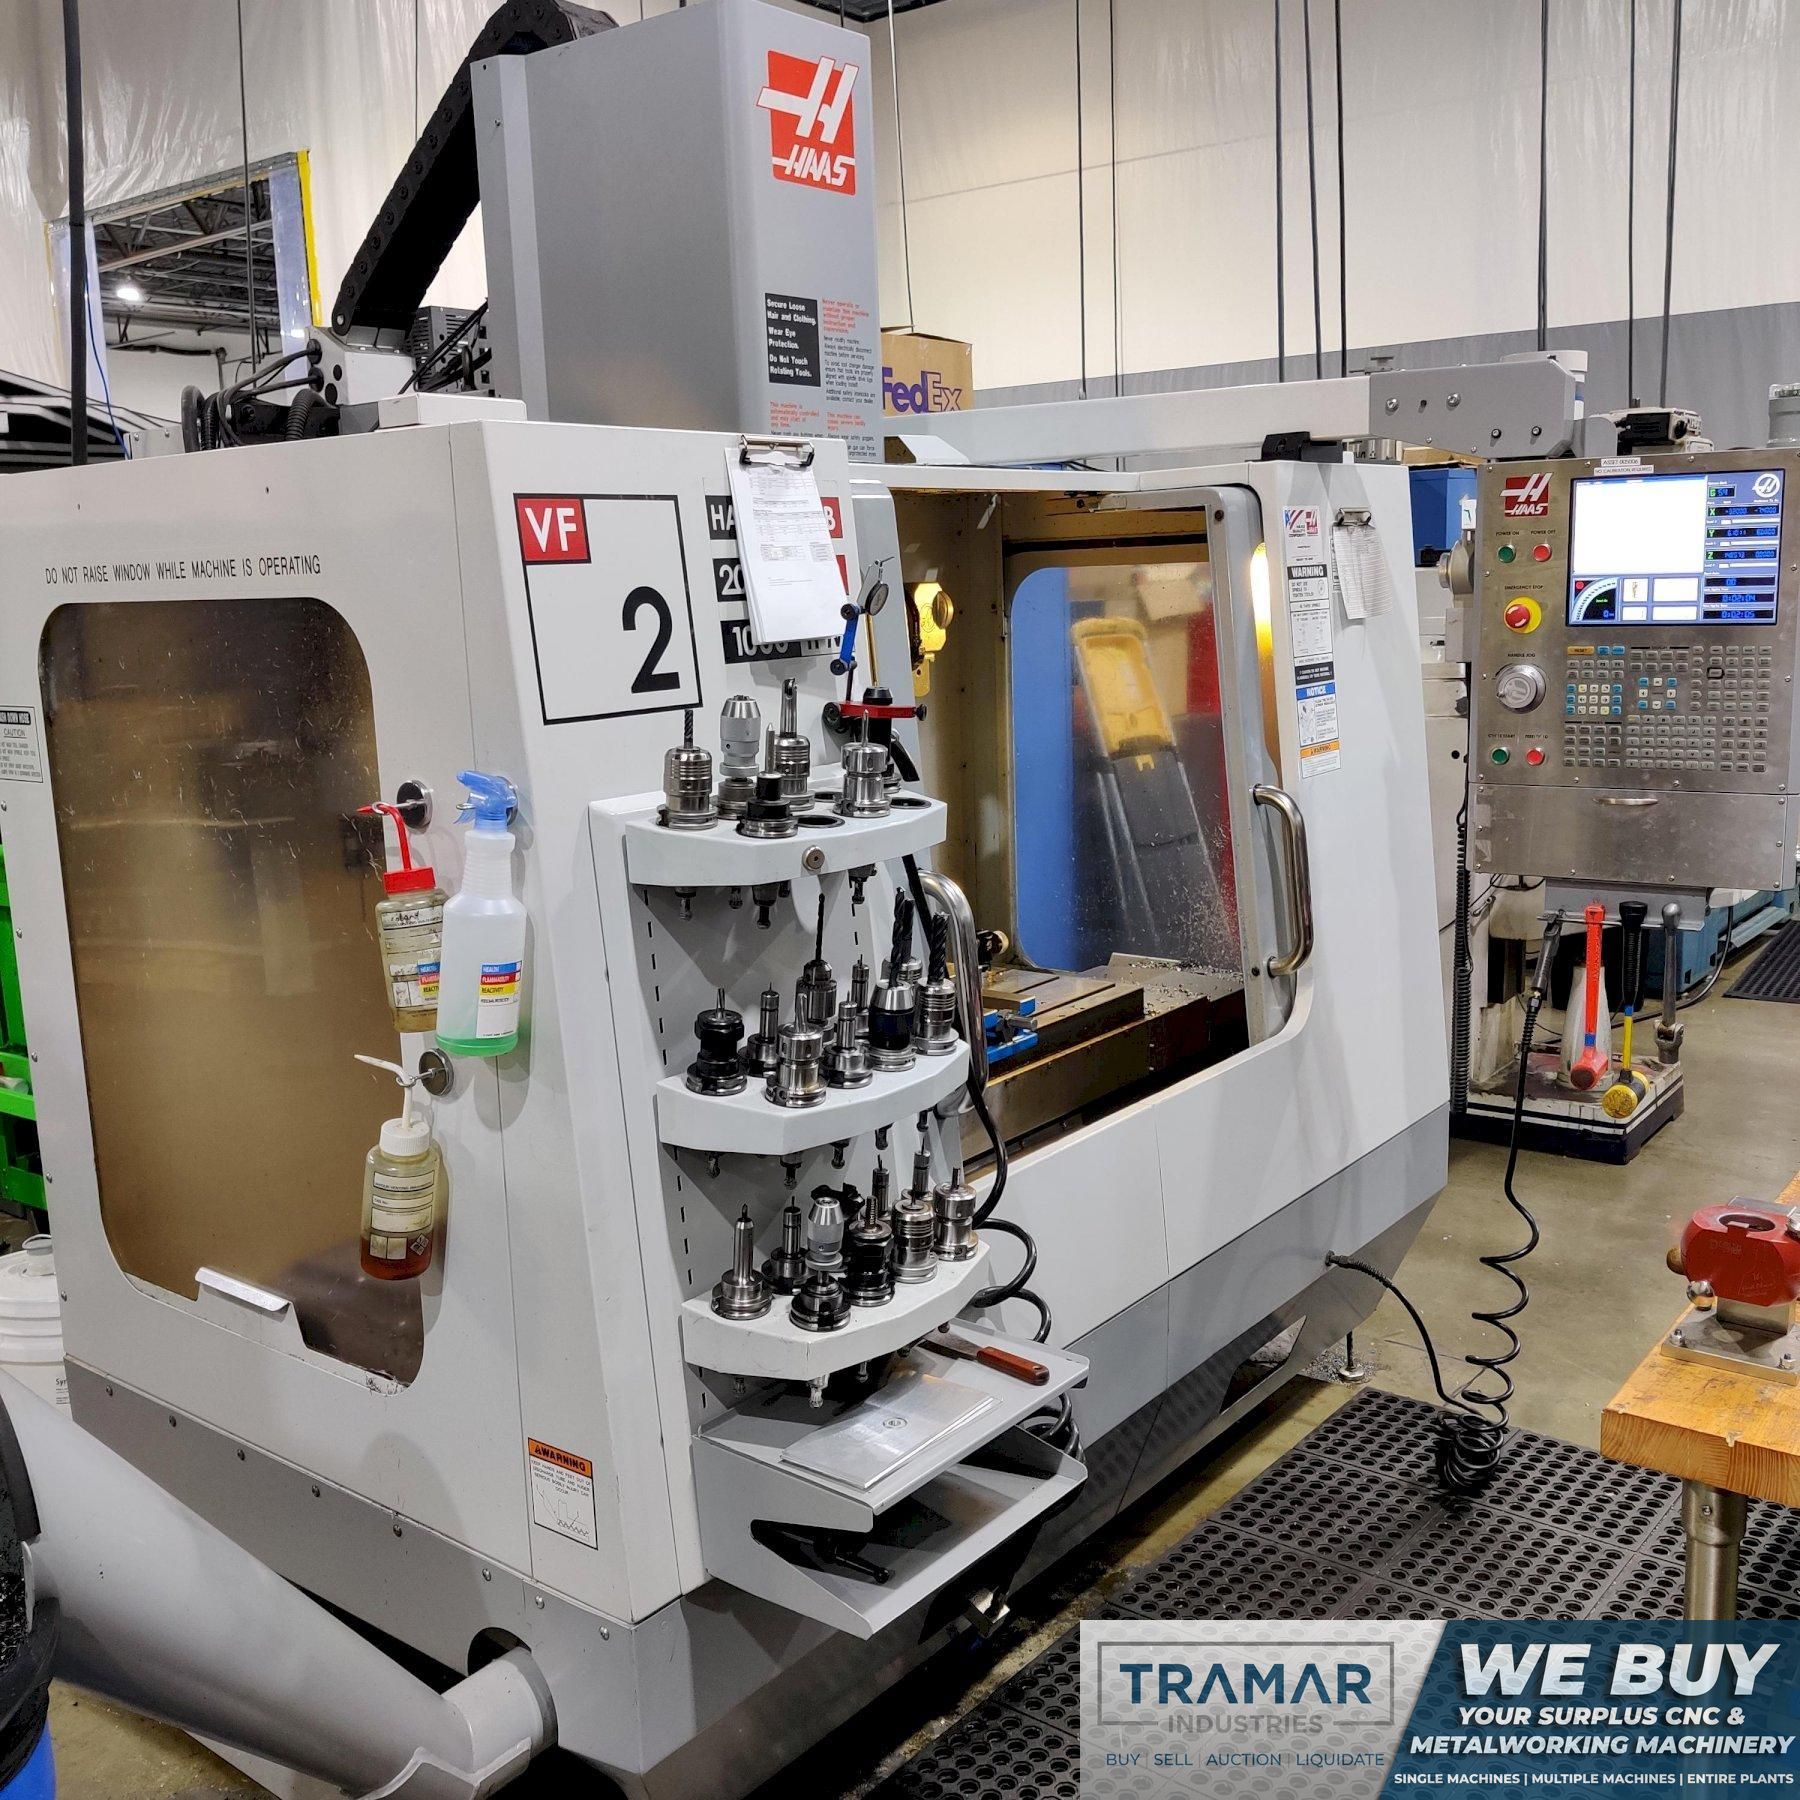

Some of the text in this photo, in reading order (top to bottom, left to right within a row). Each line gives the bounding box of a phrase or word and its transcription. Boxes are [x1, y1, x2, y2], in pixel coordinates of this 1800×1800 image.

[772, 144, 855, 187] HAAS
[767, 299, 806, 312] Secure Loose
[767, 310, 779, 320] Hair
[781, 313, 792, 321] and
[768, 326, 796, 338] Wear Eye
[769, 354, 777, 362] Do
[791, 356, 808, 365] Touch
[770, 366, 794, 377] Rotating
[882, 367, 962, 413] FedEx
[1505, 502, 1548, 516] HAAS
[525, 507, 577, 553] VF
[45, 554, 321, 584] DO NOT RAISE WINDOW WHILE MACHINE IS OPERATING
[1291, 566, 1324, 578] WARNING
[622, 586, 680, 694] 2
[1307, 685, 1326, 697] NOTICE
[541, 1447, 586, 1472] WARNING
